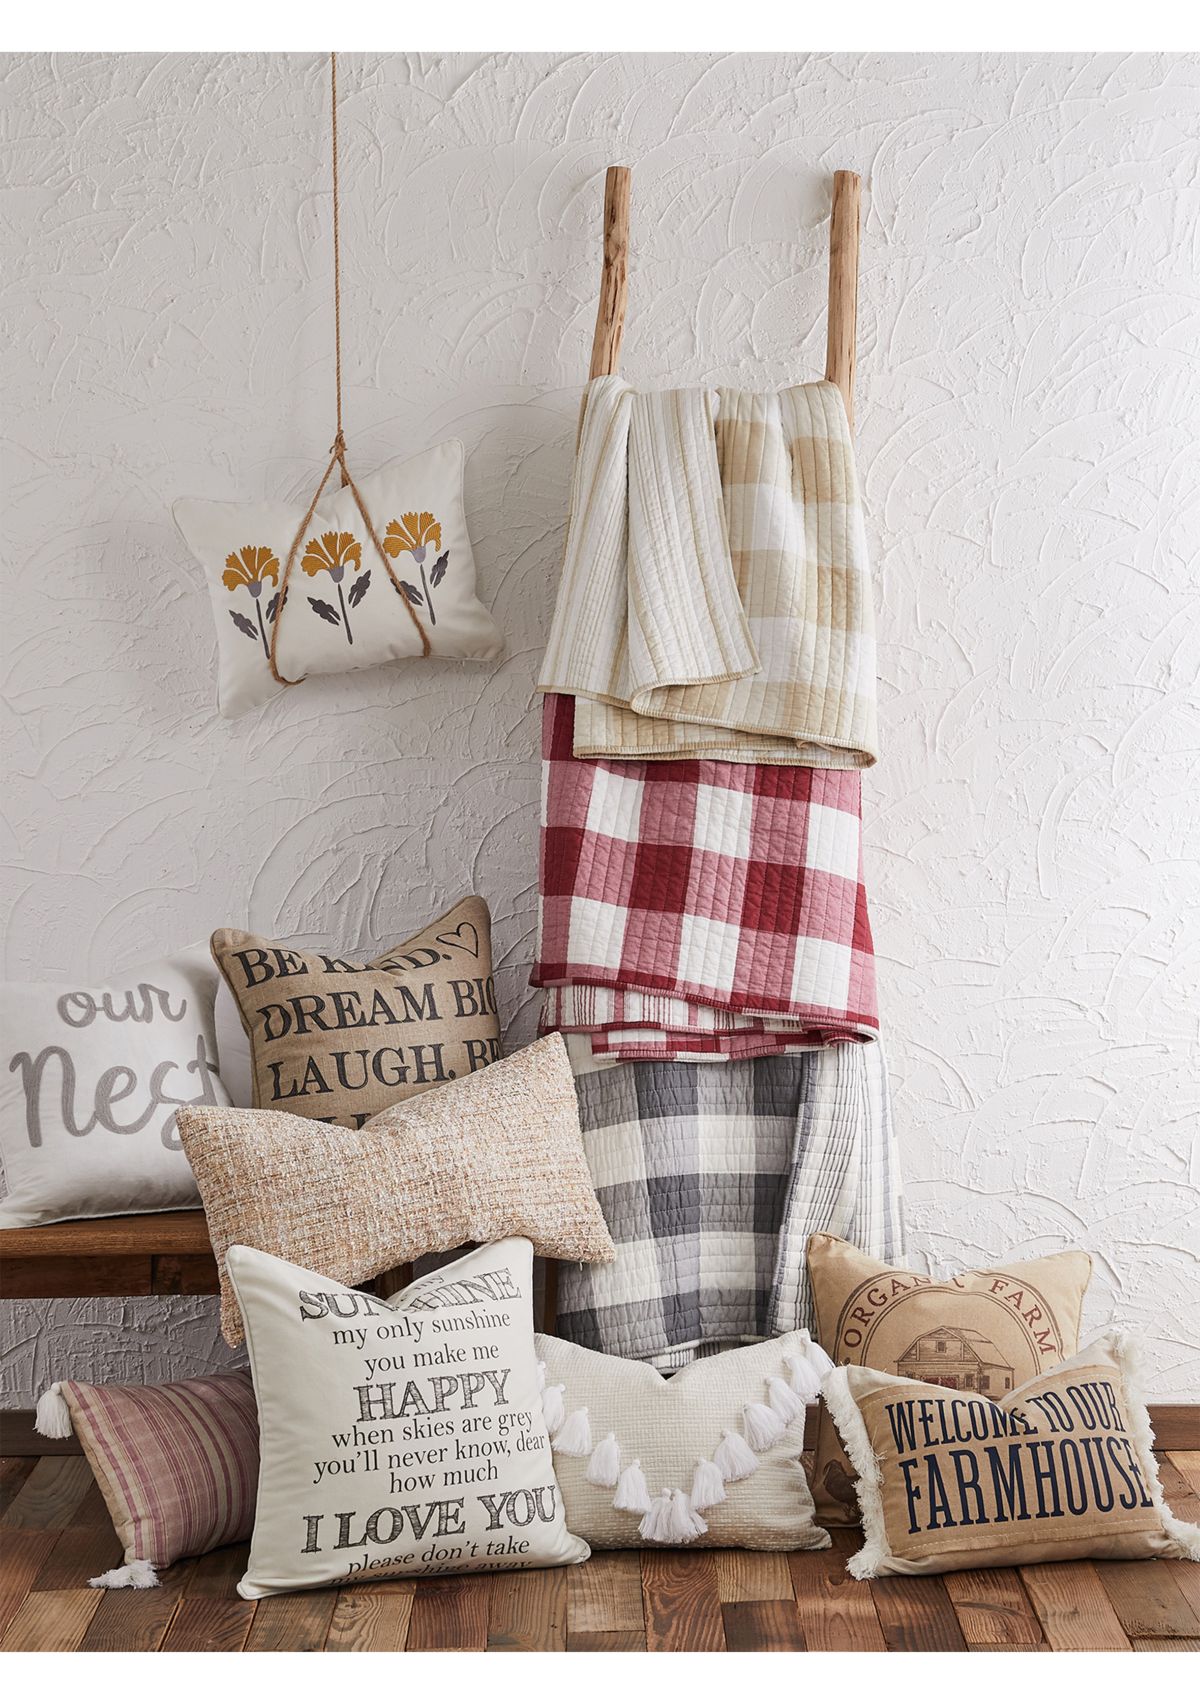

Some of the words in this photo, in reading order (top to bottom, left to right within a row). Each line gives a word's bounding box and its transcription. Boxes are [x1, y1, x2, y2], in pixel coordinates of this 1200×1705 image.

[232, 948, 309, 989] BE
[57, 983, 187, 1028] our
[256, 982, 443, 1043] DREAM
[267, 1042, 456, 1102] LAUGH.
[332, 1328, 368, 1350] my
[376, 1316, 424, 1343] only
[431, 1310, 511, 1333] sunshine
[988, 1279, 1056, 1355] FARM
[364, 1355, 406, 1380] you
[413, 1344, 467, 1368] make
[473, 1343, 500, 1360] me
[353, 1369, 511, 1423] HAPPY
[885, 1398, 1038, 1455] WELCOME
[1025, 1391, 1074, 1433] TO
[1066, 1381, 1126, 1433] OUR
[332, 1425, 394, 1448] when
[402, 1418, 454, 1441] skies
[462, 1413, 492, 1432] are
[498, 1410, 534, 1437] grey
[314, 1449, 379, 1484] you'll
[388, 1445, 448, 1469] never
[455, 1436, 512, 1460] know,
[516, 1431, 545, 1452] dear
[389, 1472, 435, 1494] how
[443, 1460, 499, 1487] much
[898, 1436, 1154, 1535] FARMHOUSE
[300, 1514, 324, 1554] I
[333, 1496, 465, 1551] LOVE
[477, 1485, 556, 1532] YOU
[348, 1553, 415, 1576] please
[421, 1541, 479, 1563] don't
[486, 1535, 530, 1556] take
